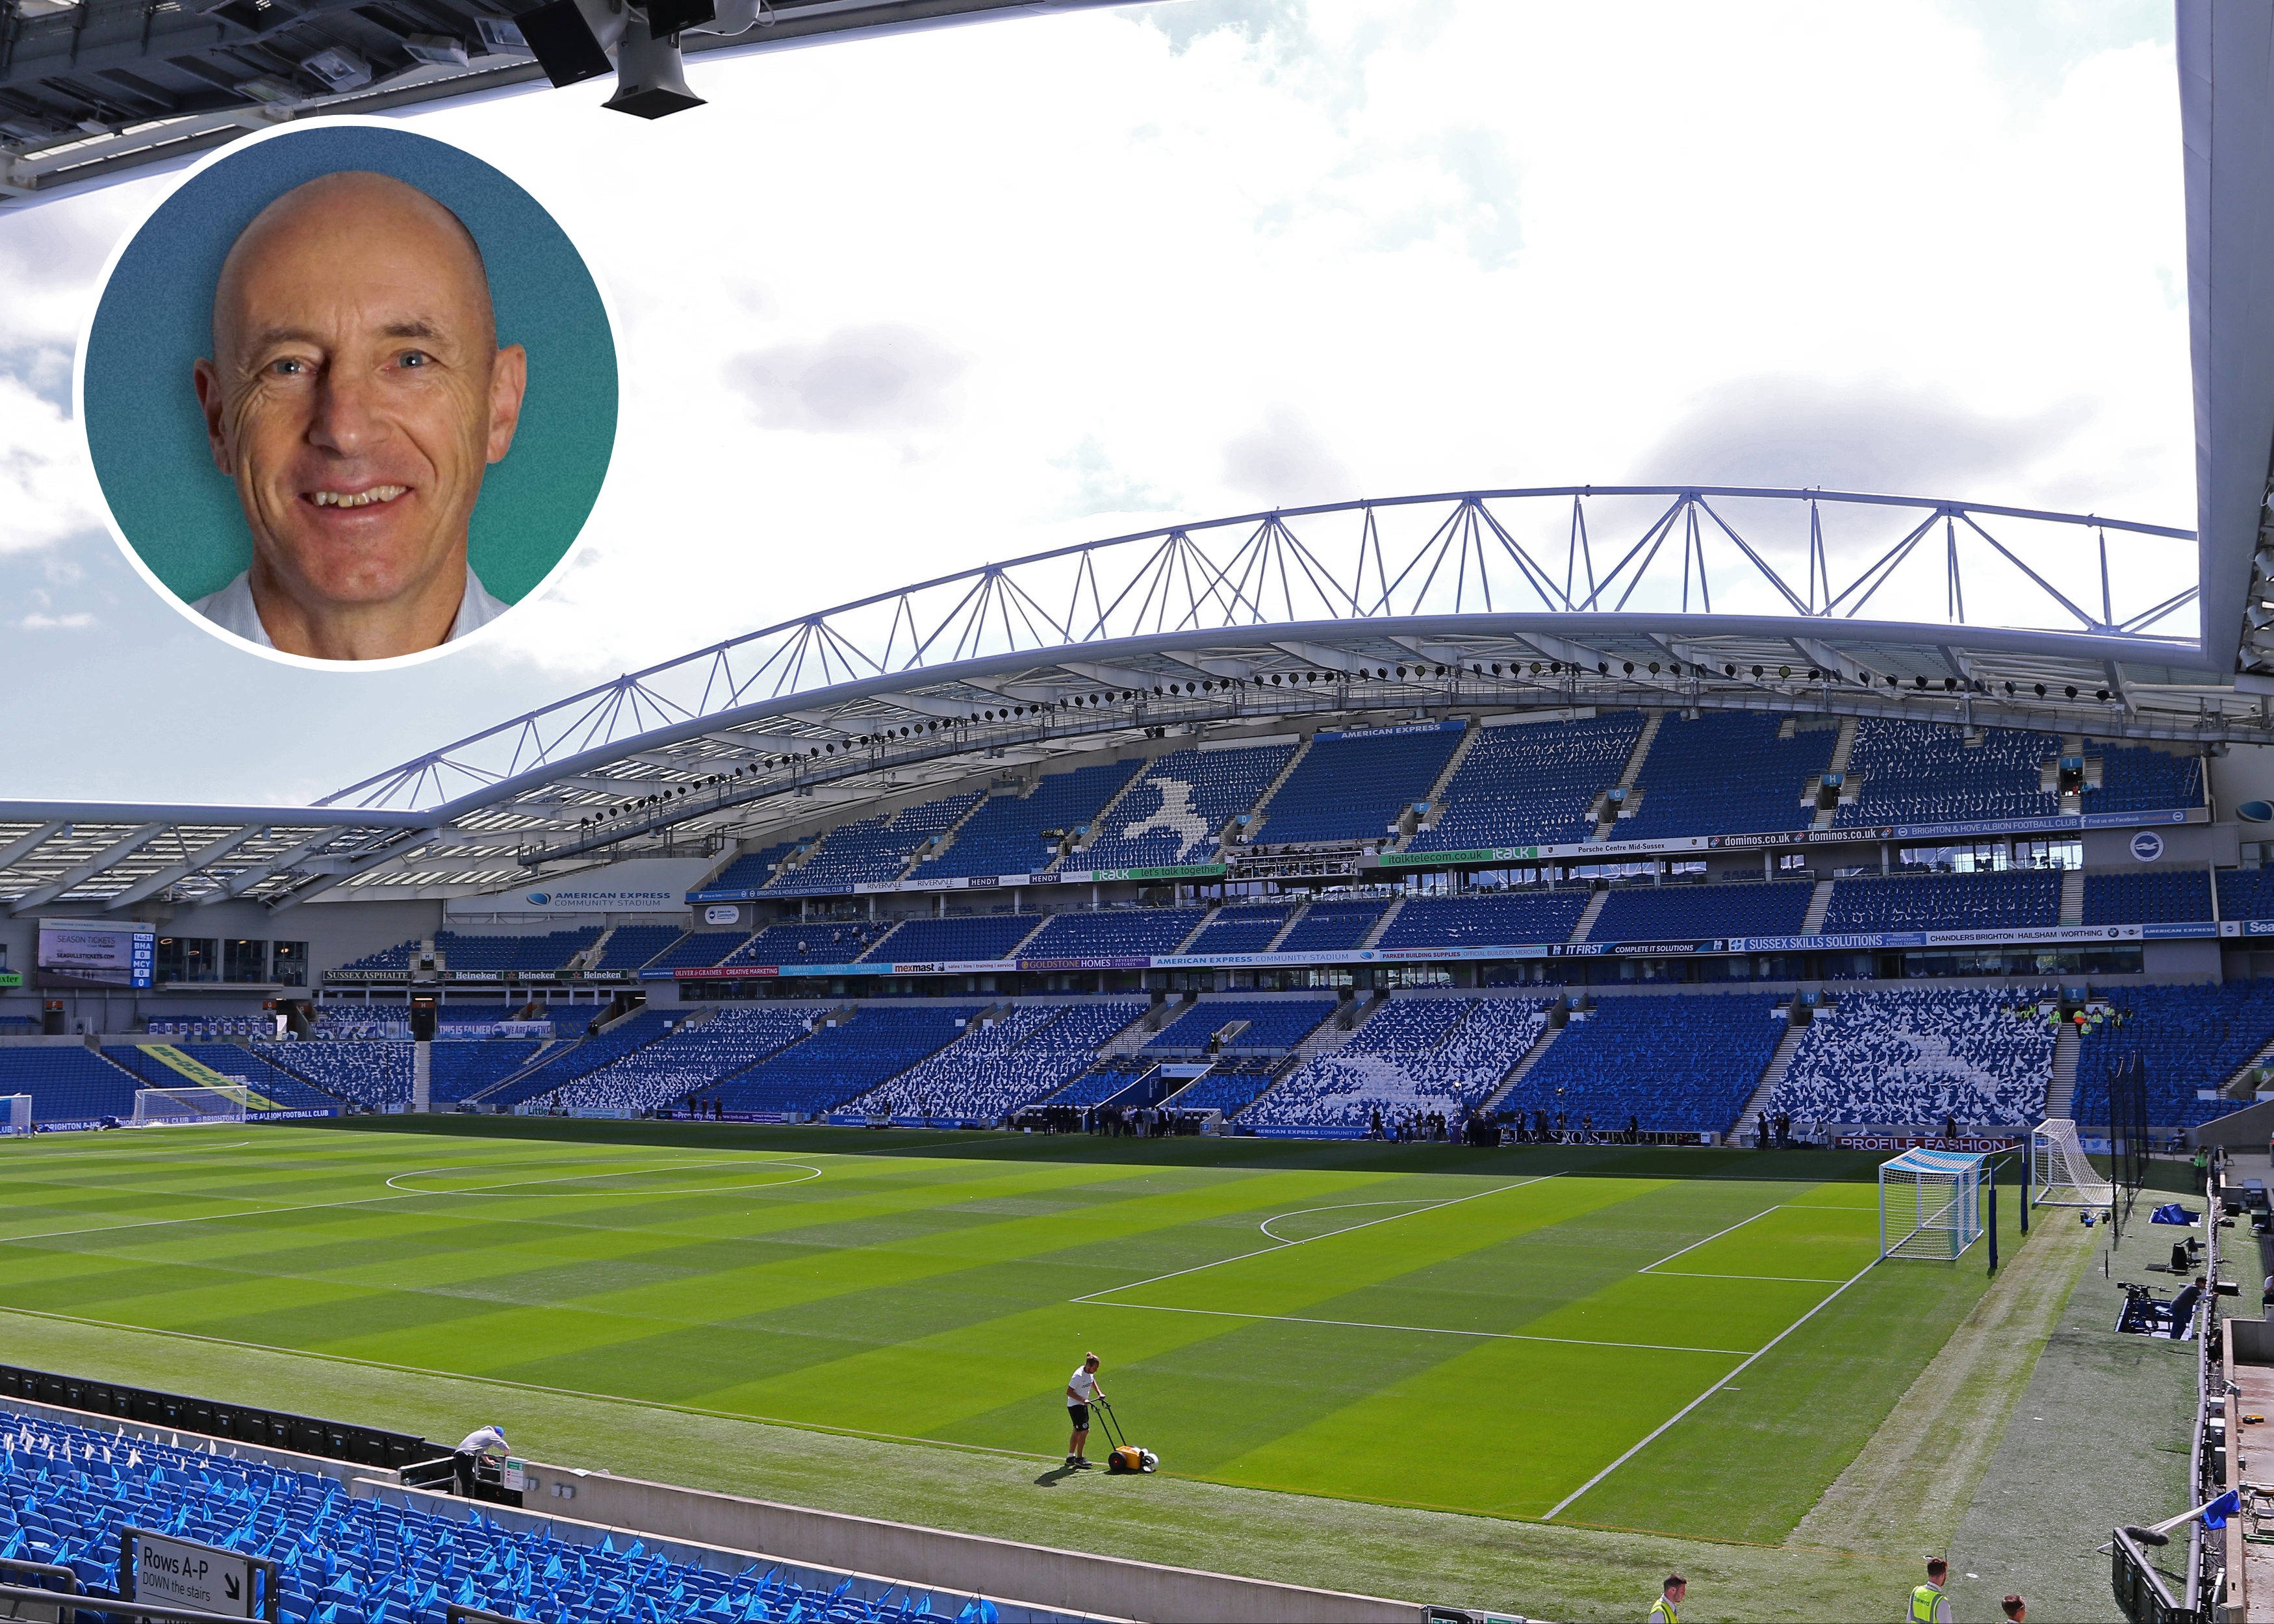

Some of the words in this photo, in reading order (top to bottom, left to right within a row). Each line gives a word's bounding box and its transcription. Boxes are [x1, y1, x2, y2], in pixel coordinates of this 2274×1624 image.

[1341, 728, 1393, 739] AMERICAN
[1396, 724, 1440, 733] EXPRESS
[1829, 774, 1836, 783] H
[1911, 825, 1951, 835] BRIGHTON
[2013, 820, 2054, 829] FOOTBALL
[2055, 818, 2077, 828] CLUB
[1724, 833, 1790, 846] dominos.co.uk
[1809, 828, 1876, 842] dominos.co.uk
[1388, 850, 1482, 864] italktelecom.co.uk
[1141, 868, 1160, 877] let's
[1162, 867, 1178, 876] talk
[1181, 865, 1220, 877] together
[1032, 874, 1058, 883] HENDY
[88, 936, 116, 945] TICKETS
[1749, 938, 1787, 950] SUSSEX
[1789, 937, 1824, 948] SKILLS
[1826, 935, 1883, 947] SOLUTIONS
[1566, 945, 1576, 955] IT
[1576, 945, 1603, 954] FIRST
[895, 963, 935, 972] mexmast
[1080, 959, 1111, 967] HOMES
[327, 971, 361, 979] SUSSEX
[362, 971, 408, 979] ASPHALTE
[455, 971, 497, 980] Heineken
[518, 971, 556, 980] Heineken
[583, 971, 621, 979] Heineken
[1808, 994, 1815, 1002] H
[439, 1025, 454, 1034] THIS
[455, 1025, 462, 1034] IS
[464, 1024, 491, 1035] FALMER
[203, 1114, 235, 1123] BRIGHTON
[1841, 1137, 1921, 1150] PROFILE
[1924, 1137, 2006, 1152] FASHION
[144, 1546, 179, 1574] Rows
[182, 1556, 209, 1580] A-P
[142, 1571, 170, 1591] DOWN
[172, 1580, 185, 1595] the
[186, 1586, 211, 1601] stairs
